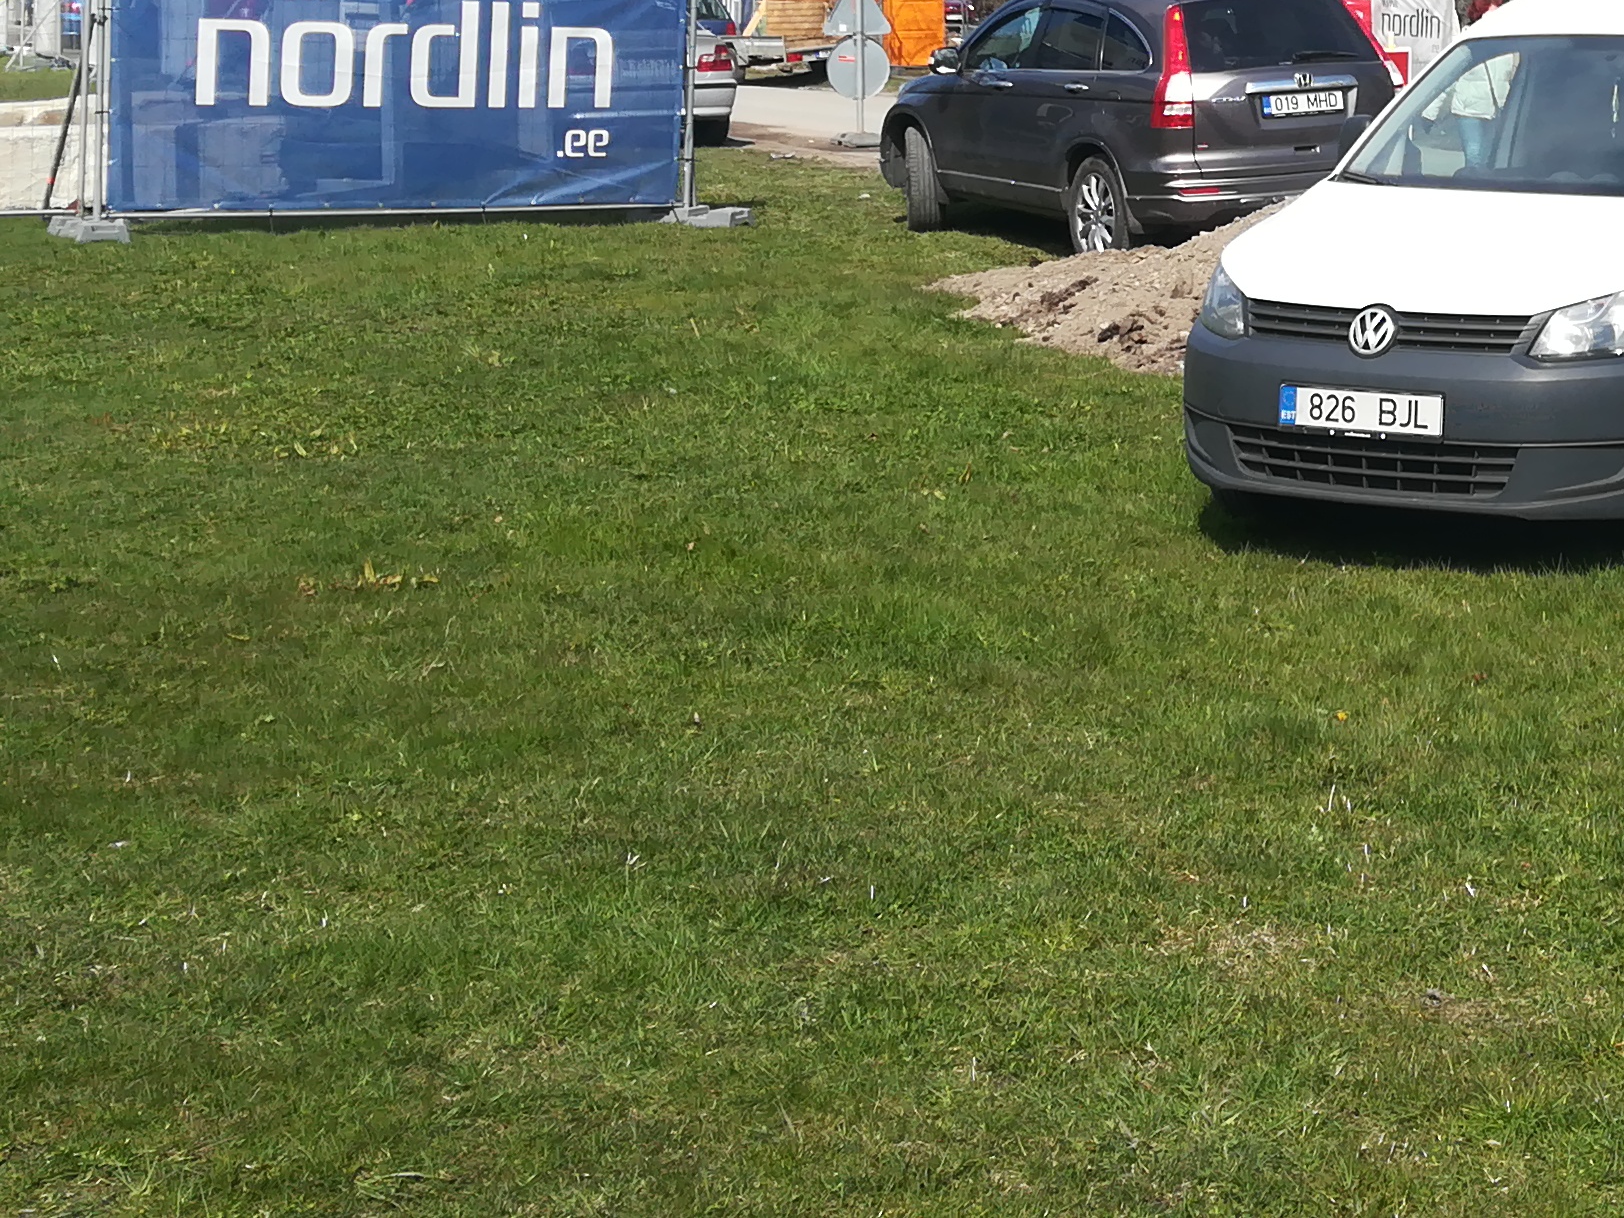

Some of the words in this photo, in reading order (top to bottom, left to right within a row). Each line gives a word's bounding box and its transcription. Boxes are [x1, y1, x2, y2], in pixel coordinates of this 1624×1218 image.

[1381, 8, 1441, 39] nordlin
[195, 0, 614, 109] nordlin
[1274, 96, 1299, 111] 019
[1307, 92, 1338, 109] MHD
[556, 128, 609, 158] .ee
[1309, 393, 1356, 423] 826
[1379, 397, 1429, 430] BJL
